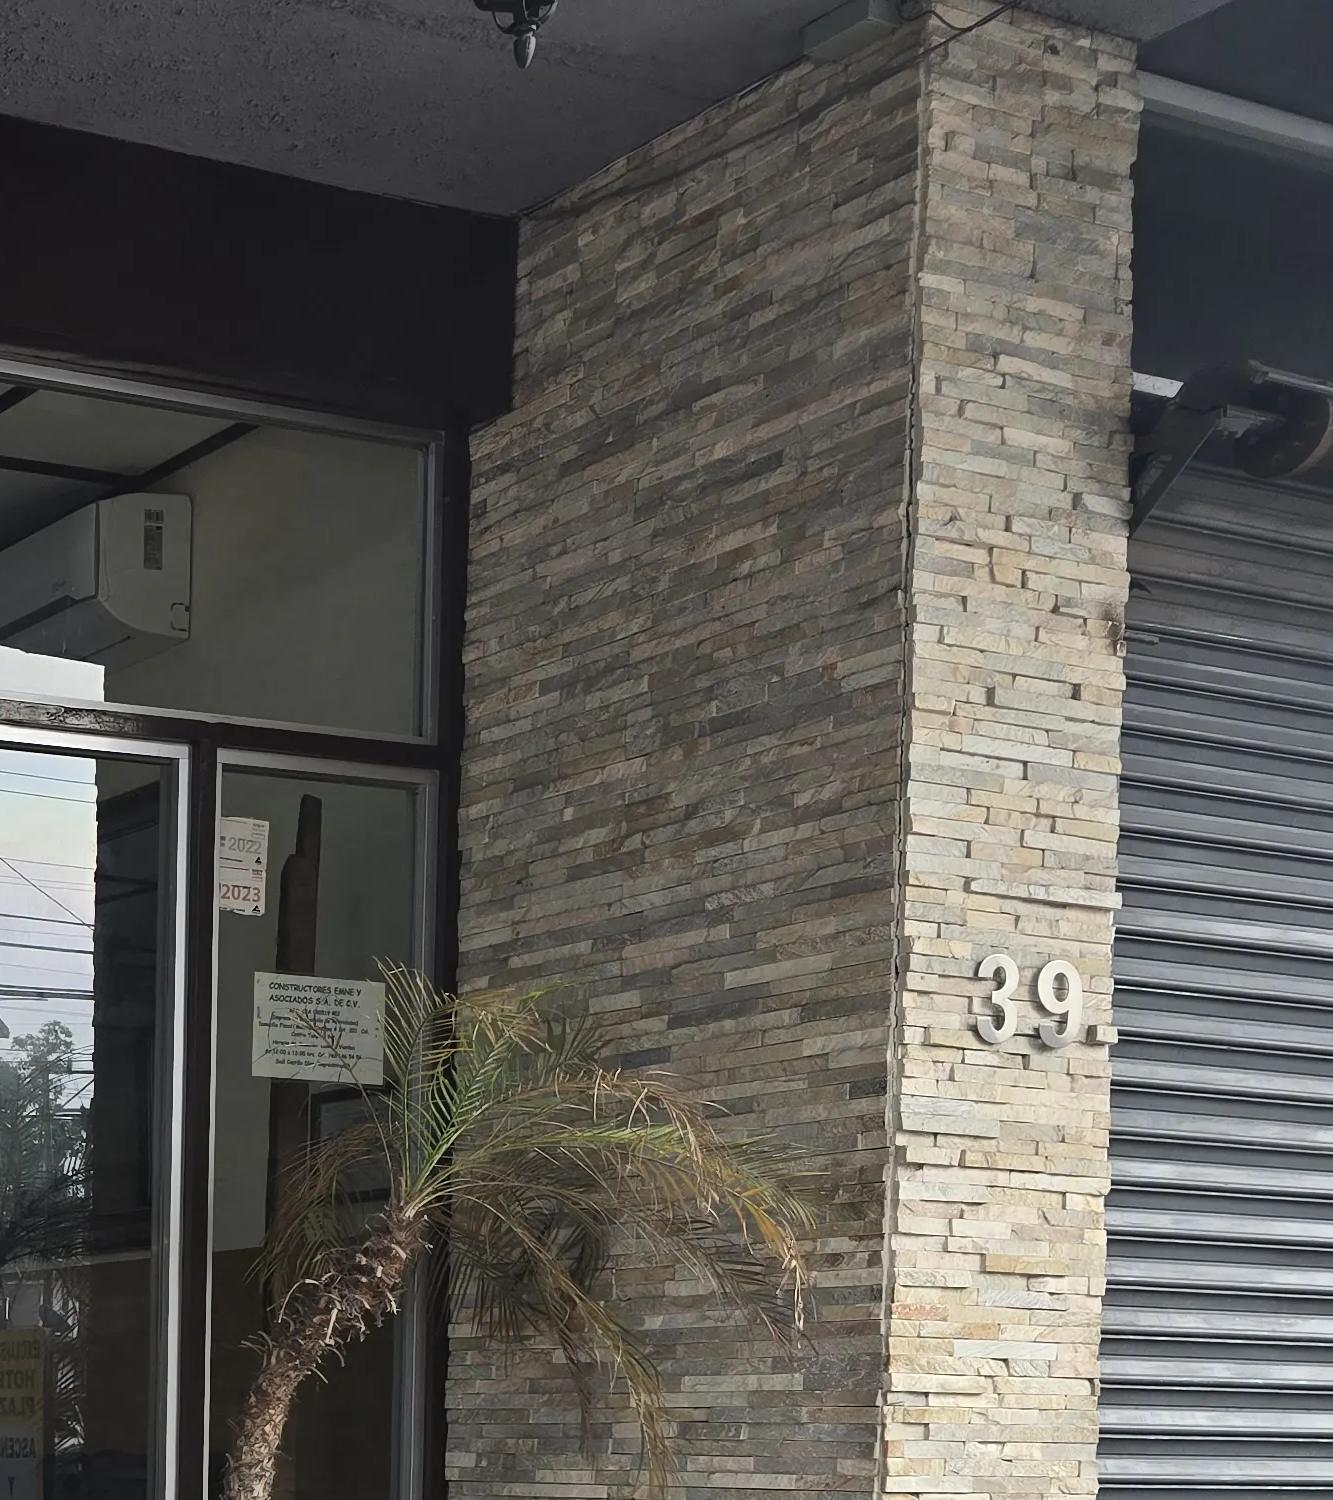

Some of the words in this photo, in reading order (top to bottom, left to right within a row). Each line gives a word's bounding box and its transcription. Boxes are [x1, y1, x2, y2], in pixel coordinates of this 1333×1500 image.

[228, 836, 262, 855] 2022
[220, 883, 261, 903] 2023
[269, 981, 332, 994] CONSTRUCTORES
[356, 988, 362, 997] Y
[269, 994, 314, 1005] ASOCIADOS
[334, 999, 344, 1007] DE
[976, 953, 1084, 1049] 39
